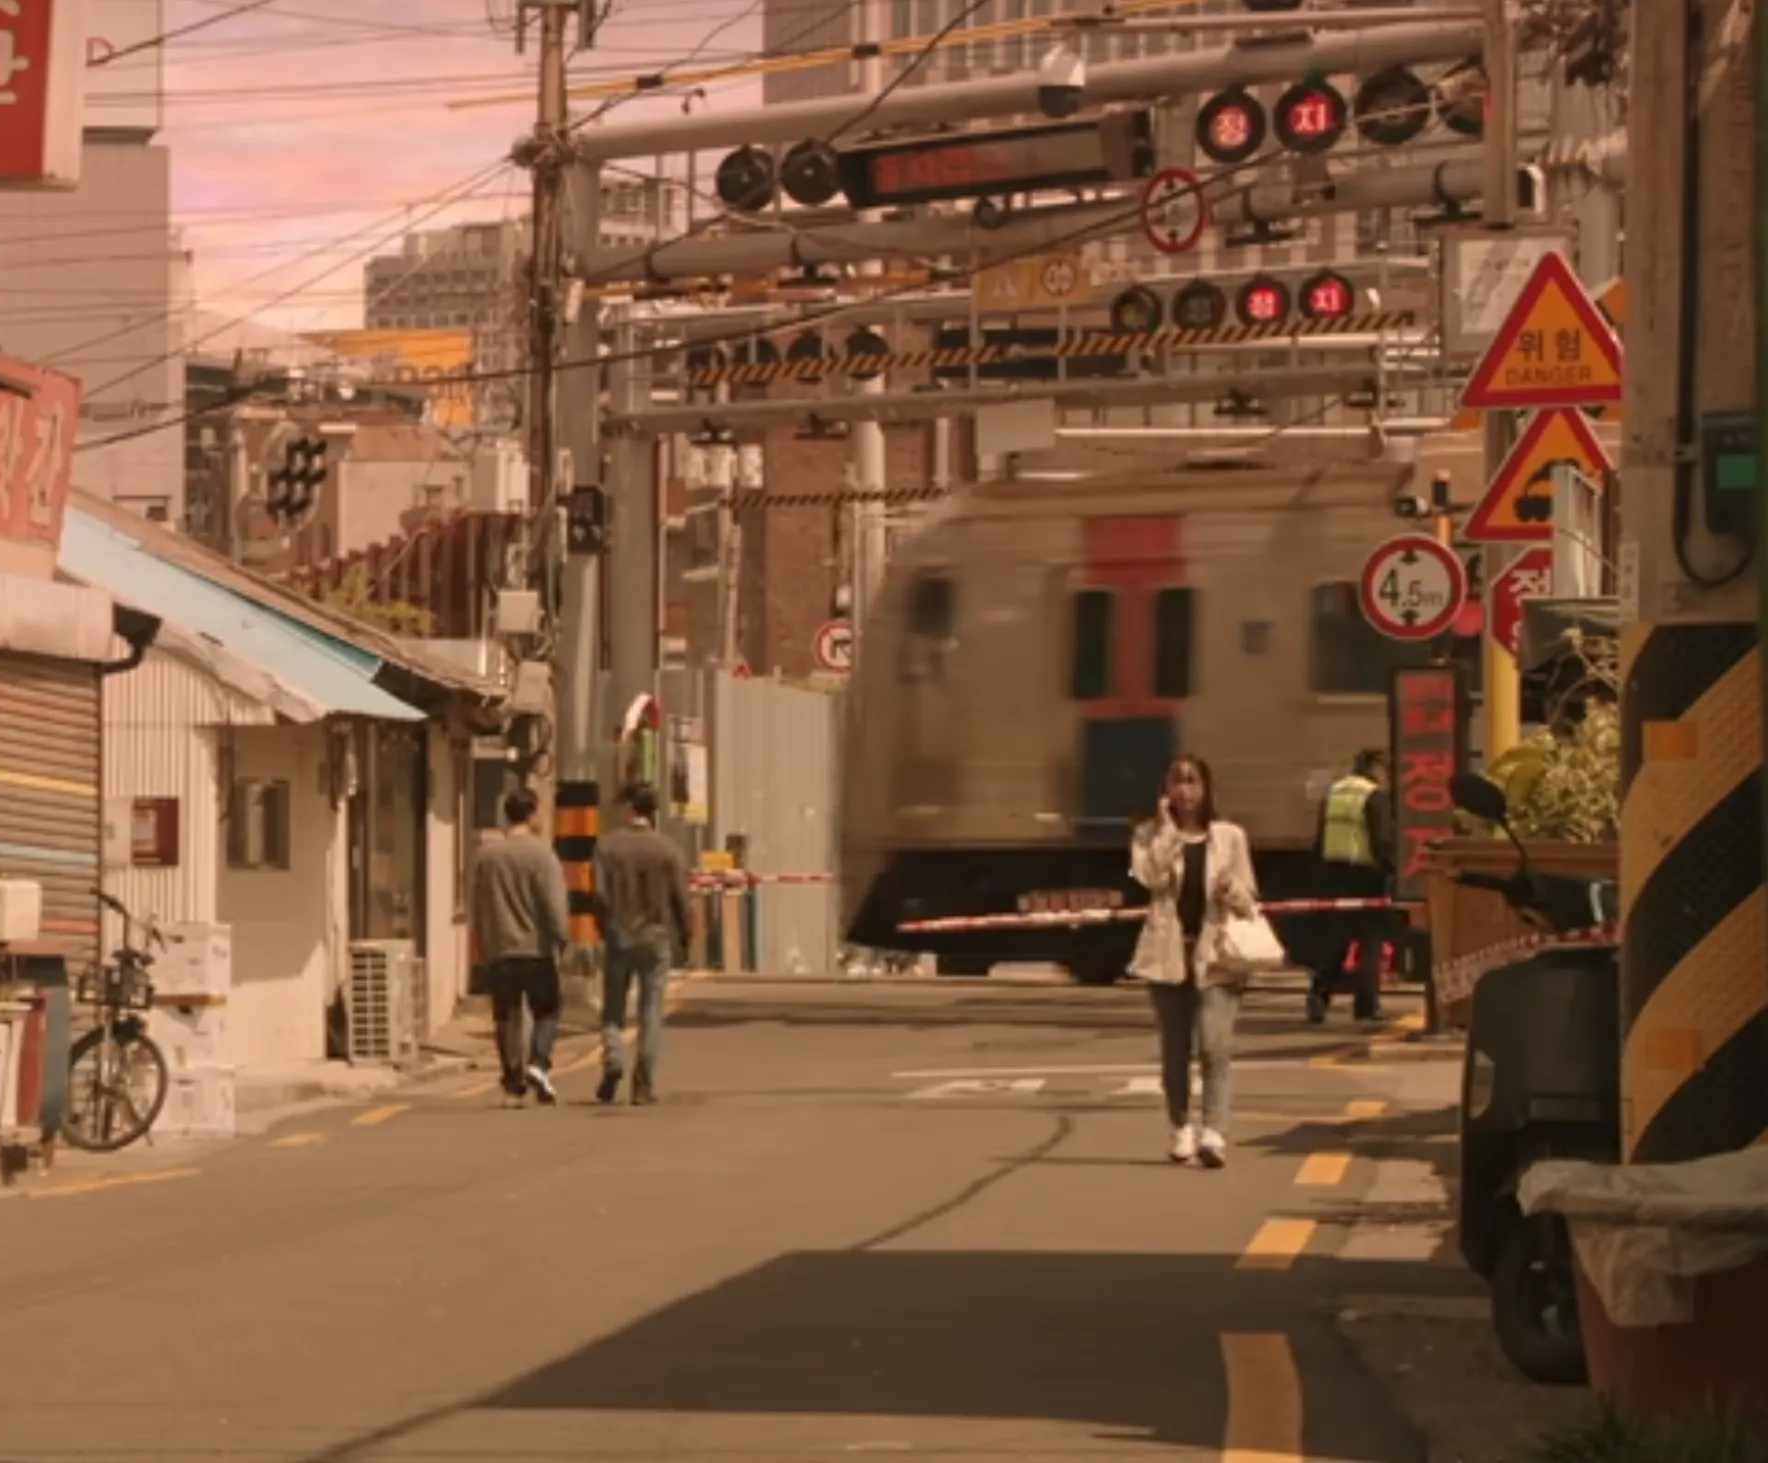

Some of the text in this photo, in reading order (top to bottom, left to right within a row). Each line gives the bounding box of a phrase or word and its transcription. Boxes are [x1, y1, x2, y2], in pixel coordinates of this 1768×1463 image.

[1516, 327, 1581, 362] 위험
[1505, 365, 1592, 386] DANGER
[1380, 568, 1445, 610] 4.5m
